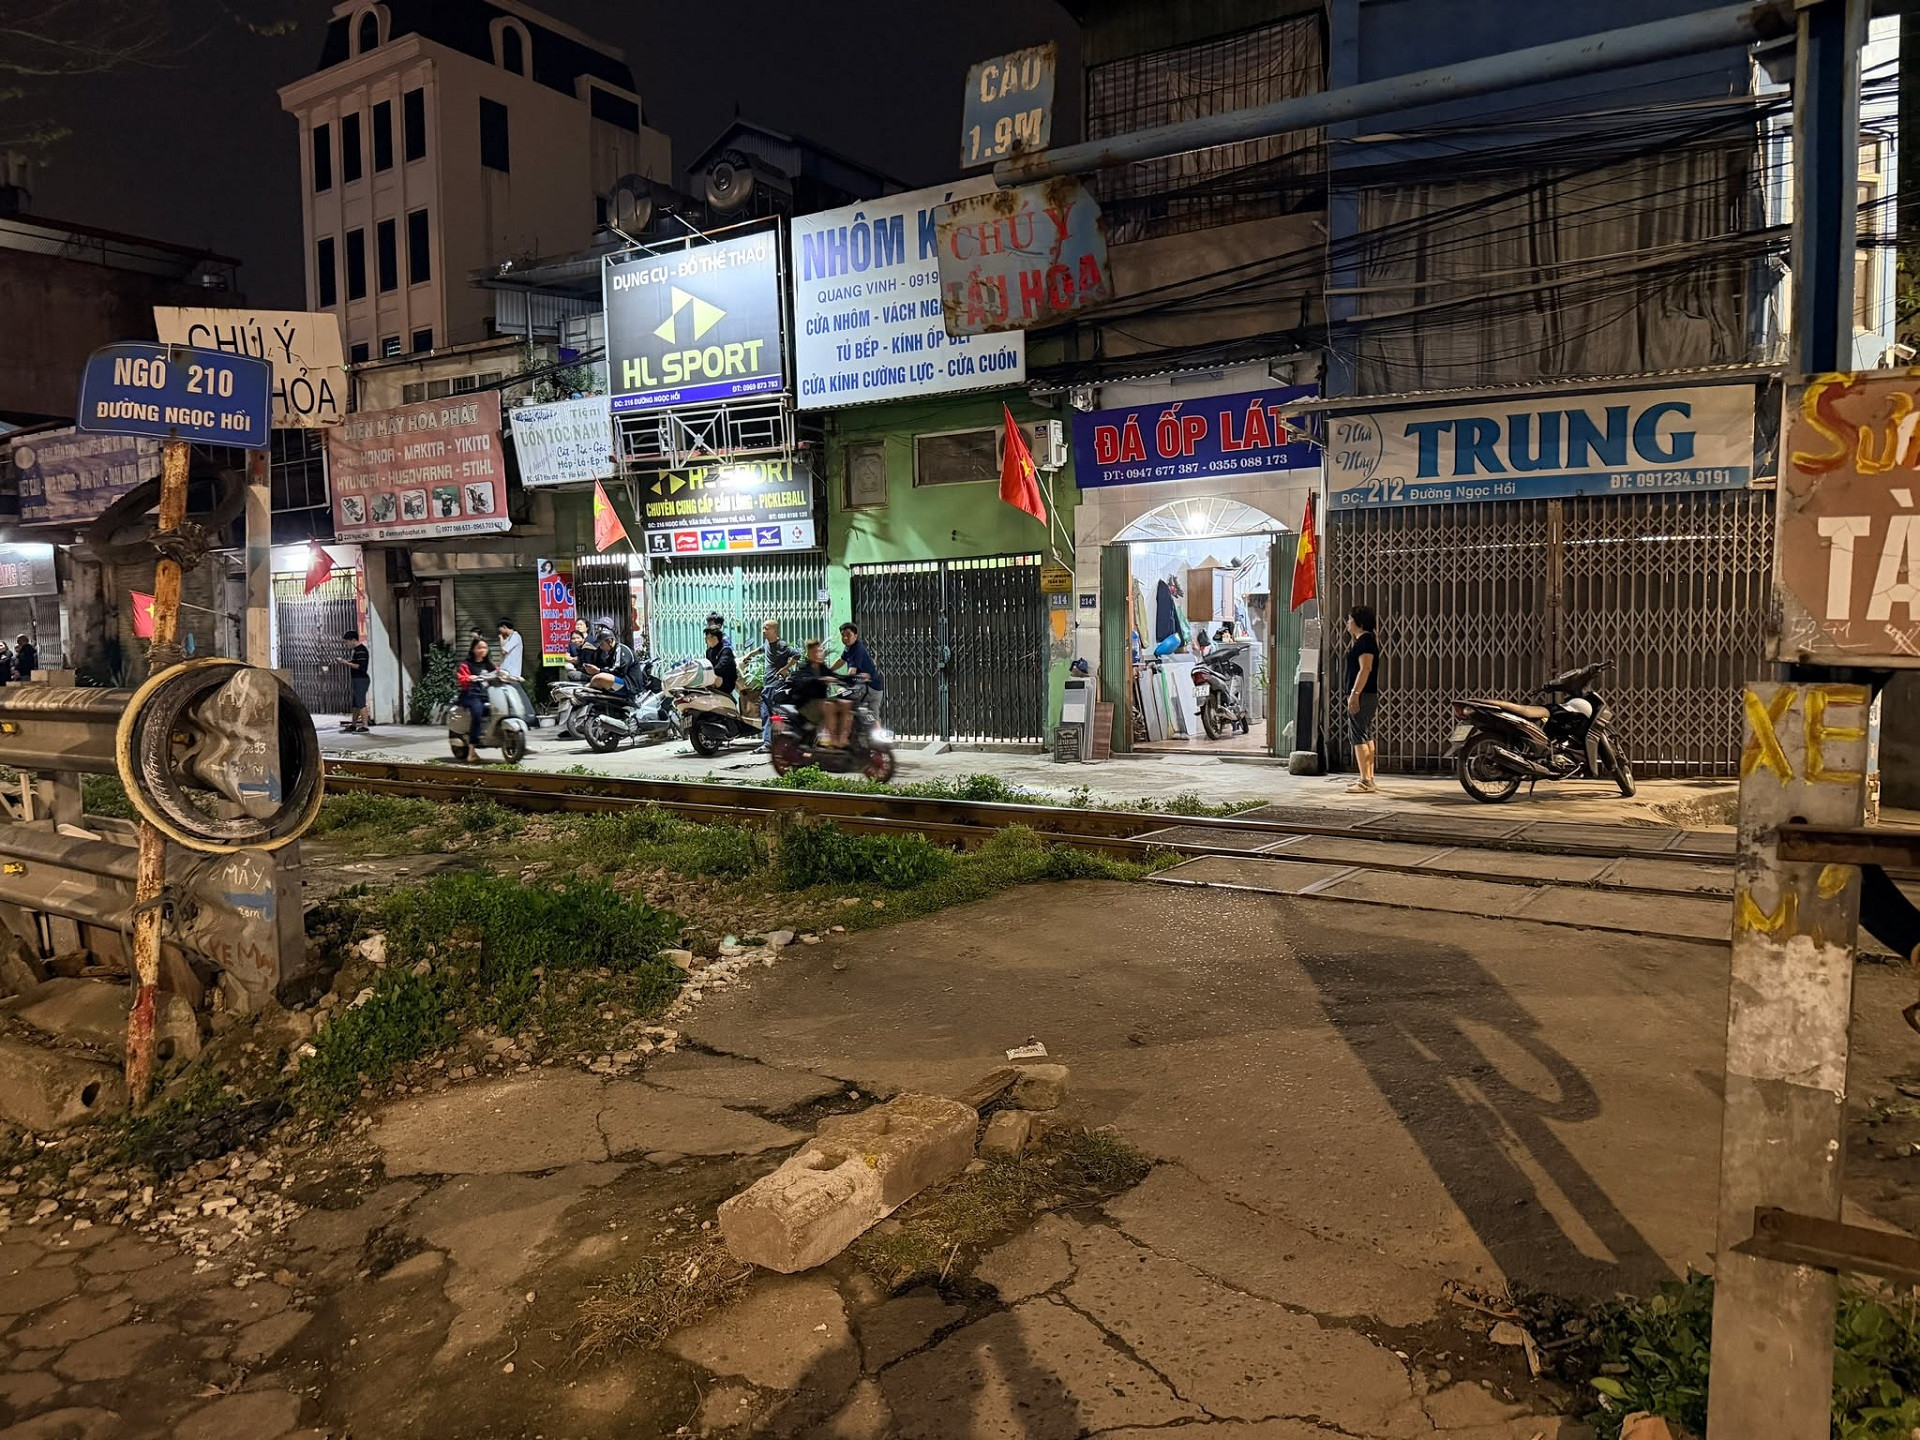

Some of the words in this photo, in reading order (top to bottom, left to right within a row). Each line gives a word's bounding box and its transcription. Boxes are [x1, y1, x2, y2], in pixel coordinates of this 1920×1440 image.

[980, 58, 1041, 103] CAO
[968, 108, 1043, 161] 1.9M
[802, 212, 904, 281] NHÔM
[950, 200, 1035, 260] CHÚ
[613, 269, 650, 292] DỤNG
[650, 266, 669, 284] CỤ
[728, 247, 767, 267] THAO
[818, 284, 862, 303] QUANG
[866, 278, 896, 296] VINH
[806, 312, 830, 336] CỬA
[833, 308, 870, 330] NHÔM
[882, 300, 916, 324] VÁCH
[273, 320, 296, 364] Ý
[836, 338, 851, 362] TỦ
[855, 335, 879, 360] BẾP
[892, 329, 923, 354] KÍNH
[927, 324, 944, 348] ỐP
[114, 355, 166, 390] NGÕ
[187, 365, 234, 398] 210
[623, 356, 658, 390] HL
[662, 339, 764, 384] SPORT
[802, 372, 826, 396] CỬA
[830, 368, 858, 392] KÍNH
[862, 362, 906, 388] CƯỜNG
[910, 362, 934, 386] LỰC
[948, 350, 974, 377] CỬA
[979, 345, 1017, 374] CUỐN
[97, 398, 160, 422] ĐƯỜNG
[165, 406, 215, 430] NGỌC
[220, 410, 250, 432] HỒI
[1094, 413, 1146, 464] ĐÁ
[1156, 402, 1208, 458] ỐP
[1220, 398, 1289, 452] LÁT
[1338, 423, 1372, 444] Nhà
[360, 448, 395, 466] HONDA
[404, 441, 445, 461] MAKITA
[454, 434, 490, 454] YIKITO
[1404, 402, 1697, 478] TRUNG
[336, 474, 380, 491] HYUNDAI
[388, 464, 453, 486] HUSQVARNA
[462, 459, 494, 478] STIHL
[1103, 470, 1124, 481] ĐT:
[1126, 467, 1152, 479] 0947
[1156, 465, 1176, 477] 677
[1178, 462, 1199, 474] 387
[1208, 458, 1238, 471] 0355
[1240, 456, 1262, 468] 088
[1266, 454, 1288, 466] 173
[1610, 474, 1632, 489] ĐT:
[1636, 470, 1730, 488] 091234.9191
[646, 498, 676, 517] CHUYÊN
[676, 498, 697, 516] CUNG
[758, 490, 806, 509] PICKLEBALL
[1342, 494, 1364, 504] ĐC:
[1366, 476, 1405, 502] 212
[1410, 487, 1451, 500] Đường
[1456, 485, 1490, 500] Ngọc
[1494, 482, 1516, 495] Hồi
[1053, 595, 1067, 605] 214
[1740, 685, 1867, 788] XE
